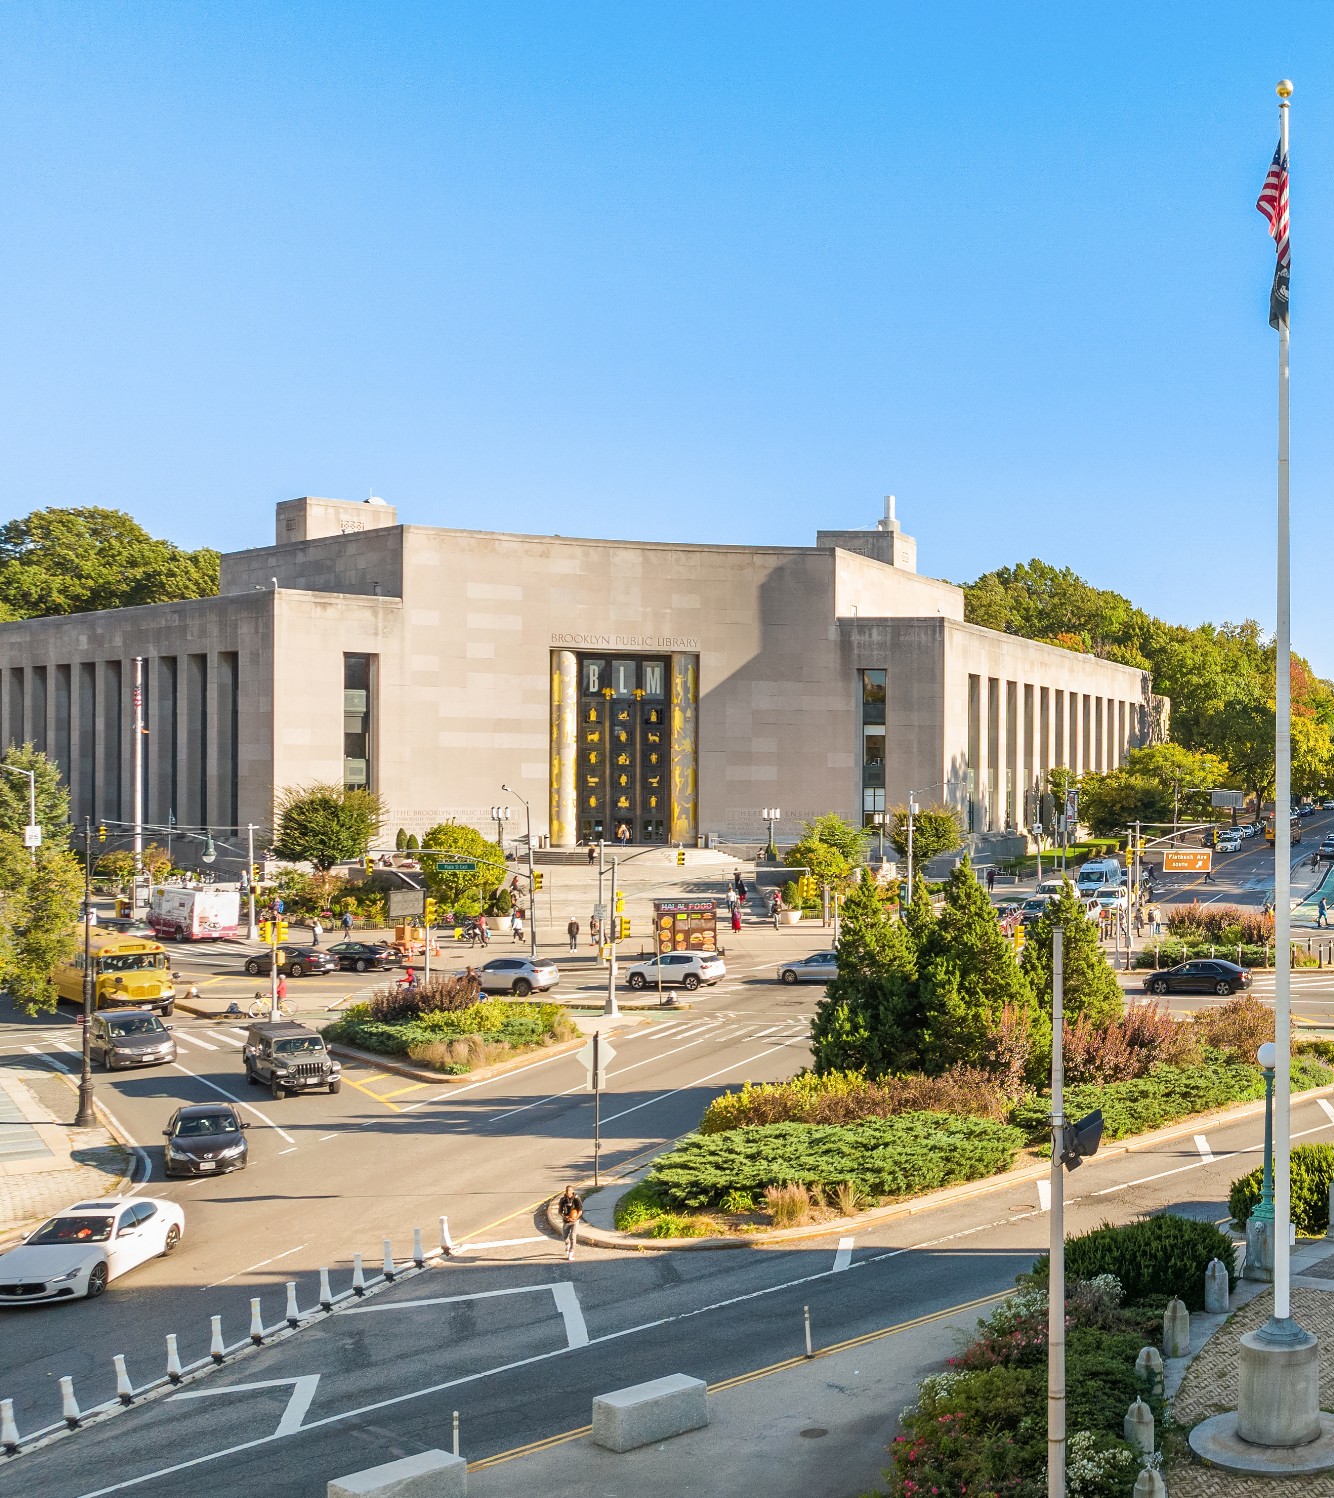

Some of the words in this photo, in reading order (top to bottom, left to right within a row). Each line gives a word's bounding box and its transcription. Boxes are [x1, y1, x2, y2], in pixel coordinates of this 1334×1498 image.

[551, 633, 610, 645] BROOKLYN
[615, 636, 653, 646] PUBLIC
[657, 637, 700, 648] LIBRARY
[688, 902, 713, 910] FOOD
